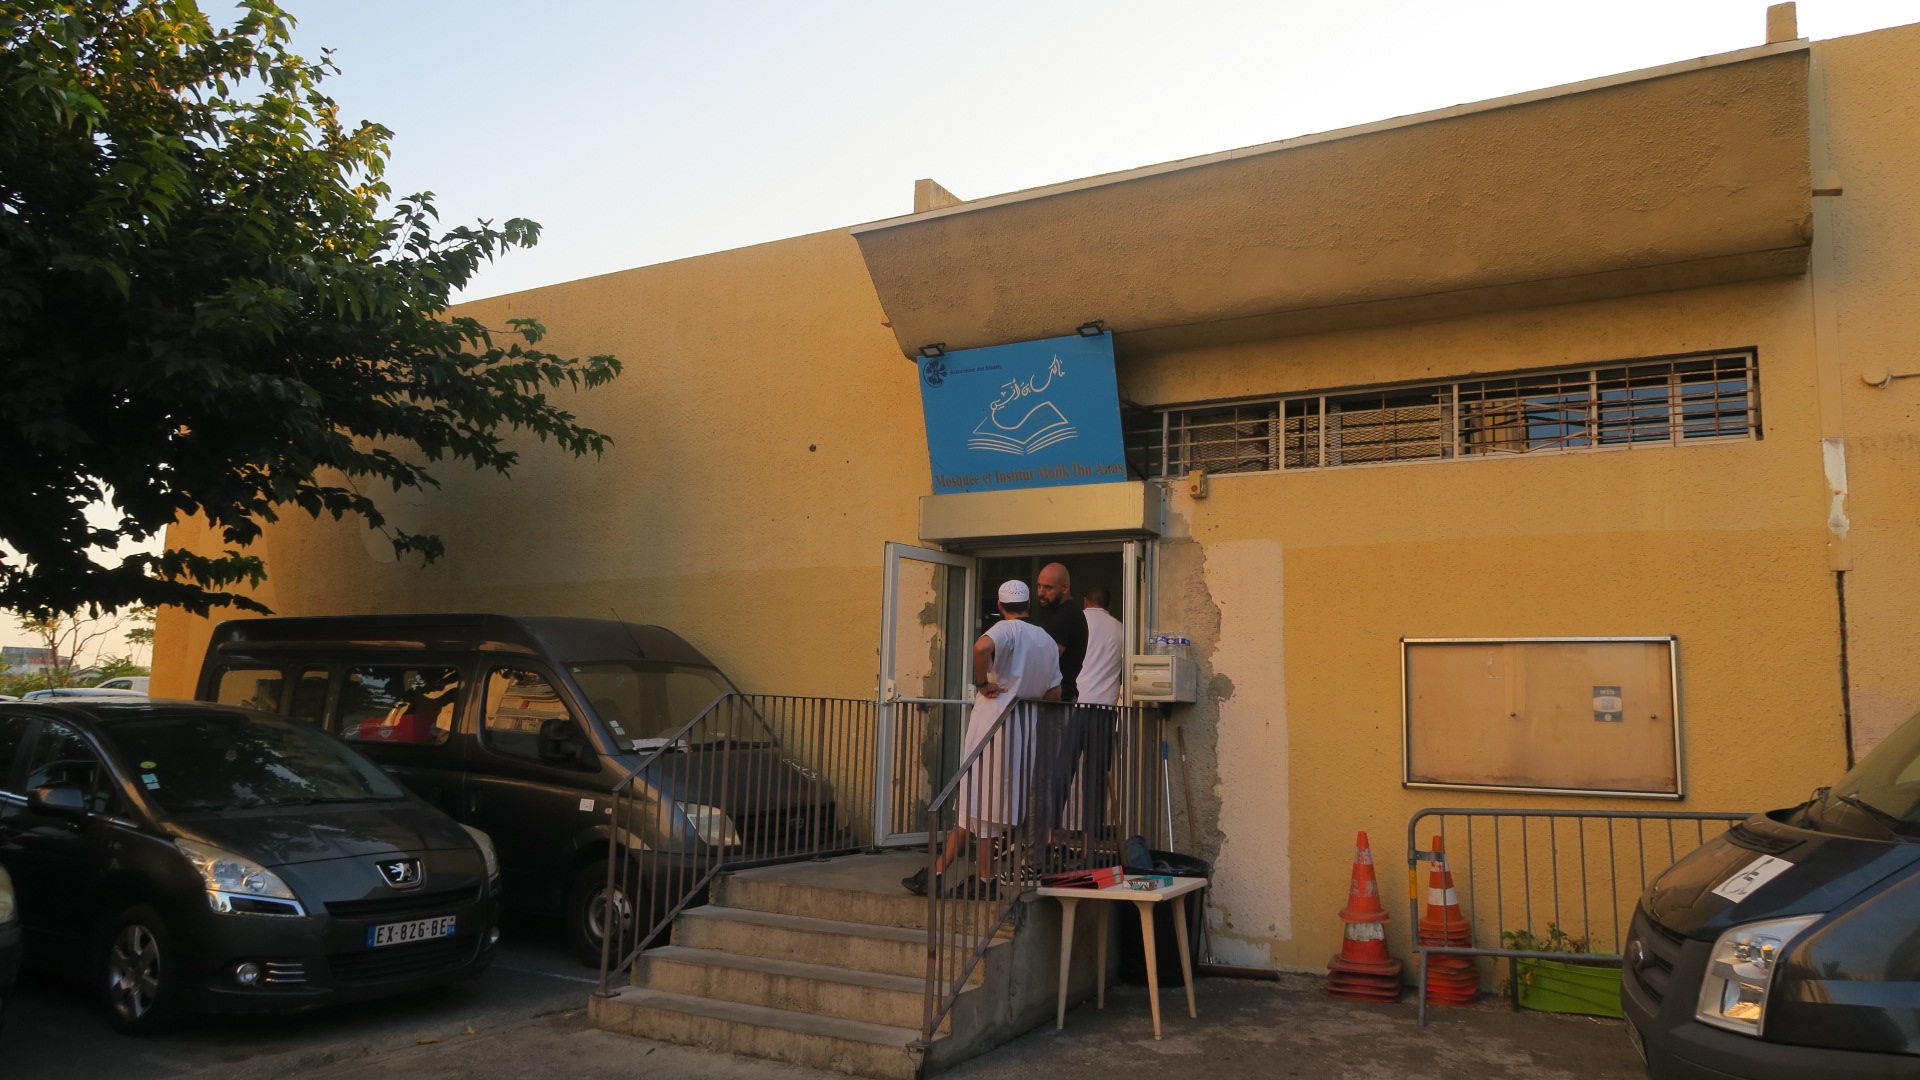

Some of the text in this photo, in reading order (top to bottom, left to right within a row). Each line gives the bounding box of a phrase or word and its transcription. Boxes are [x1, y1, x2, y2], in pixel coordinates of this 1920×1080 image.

[935, 472, 980, 490] Mosquée
[982, 472, 993, 484] et
[994, 467, 1034, 484] Institut
[1036, 464, 1070, 479] Malik
[1072, 463, 1093, 477] Ibn
[376, 918, 448, 944] EX-826-BE
